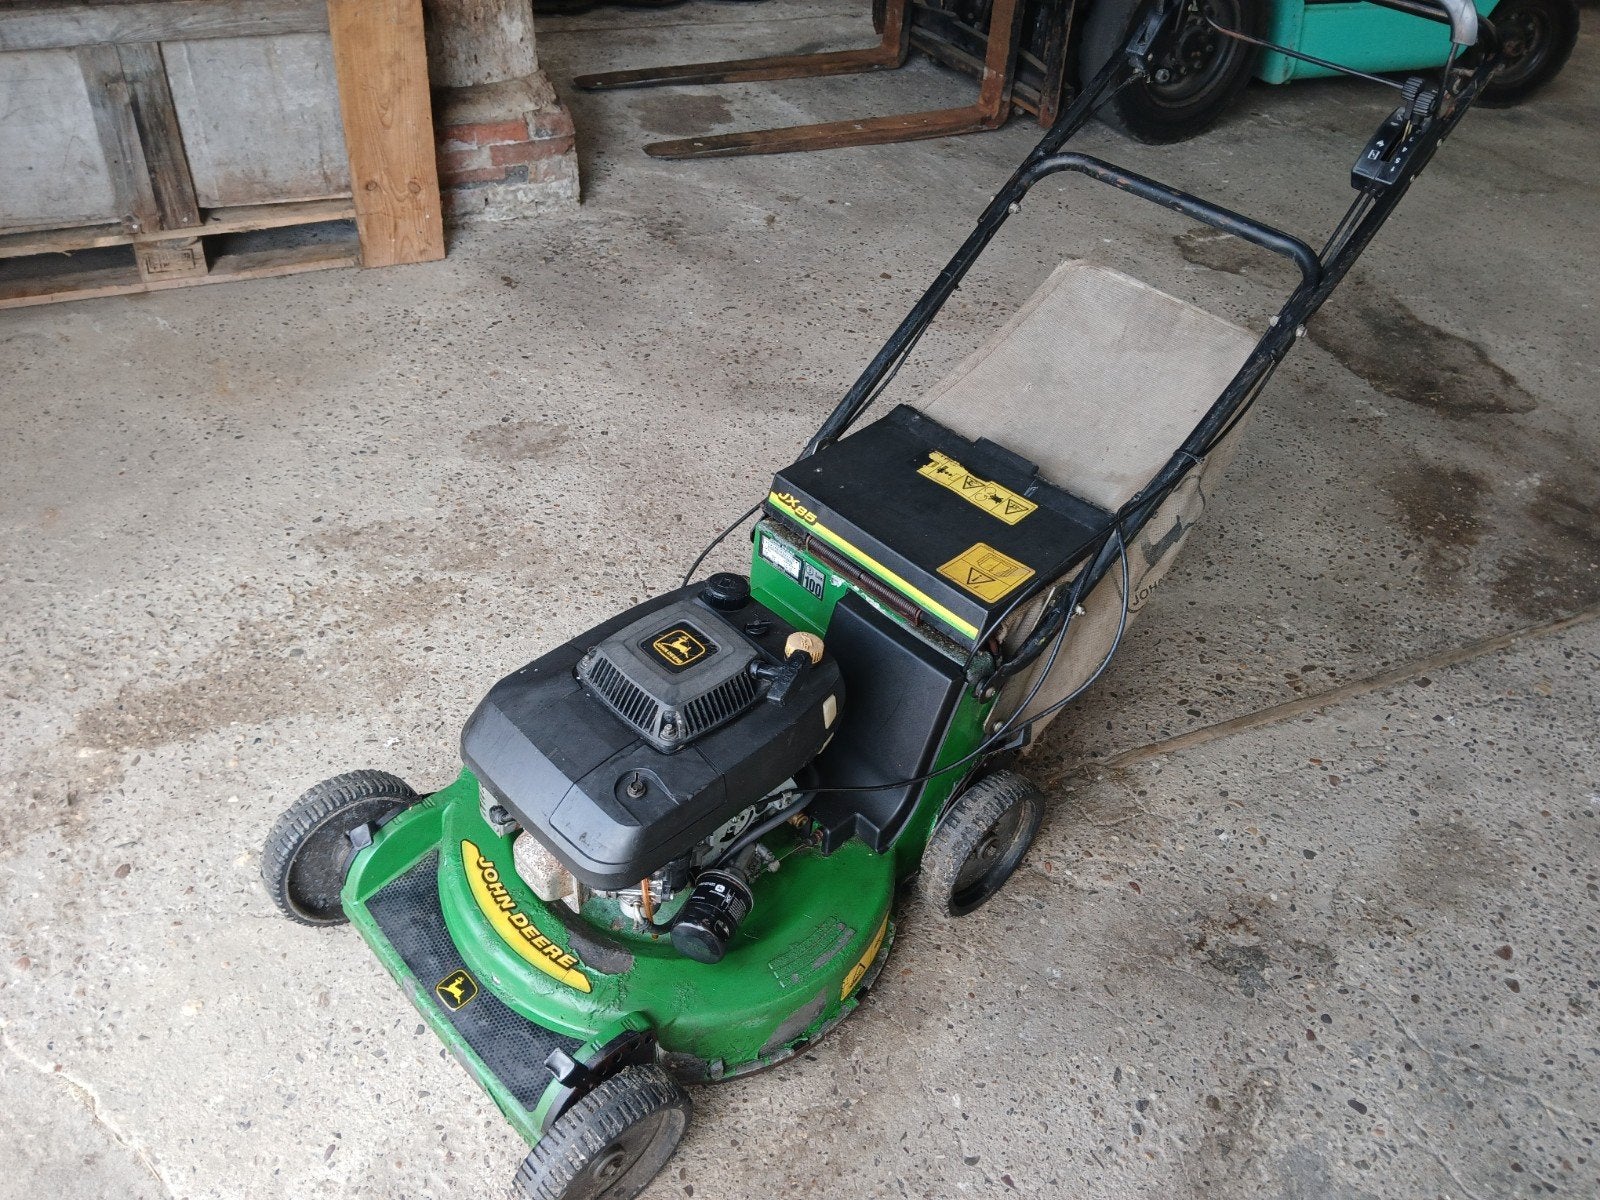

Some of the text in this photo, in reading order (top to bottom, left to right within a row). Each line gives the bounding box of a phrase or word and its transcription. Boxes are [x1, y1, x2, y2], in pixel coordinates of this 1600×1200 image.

[777, 492, 818, 525] JX85
[804, 576, 822, 599] 100
[477, 856, 580, 971] JOHN DEERE
